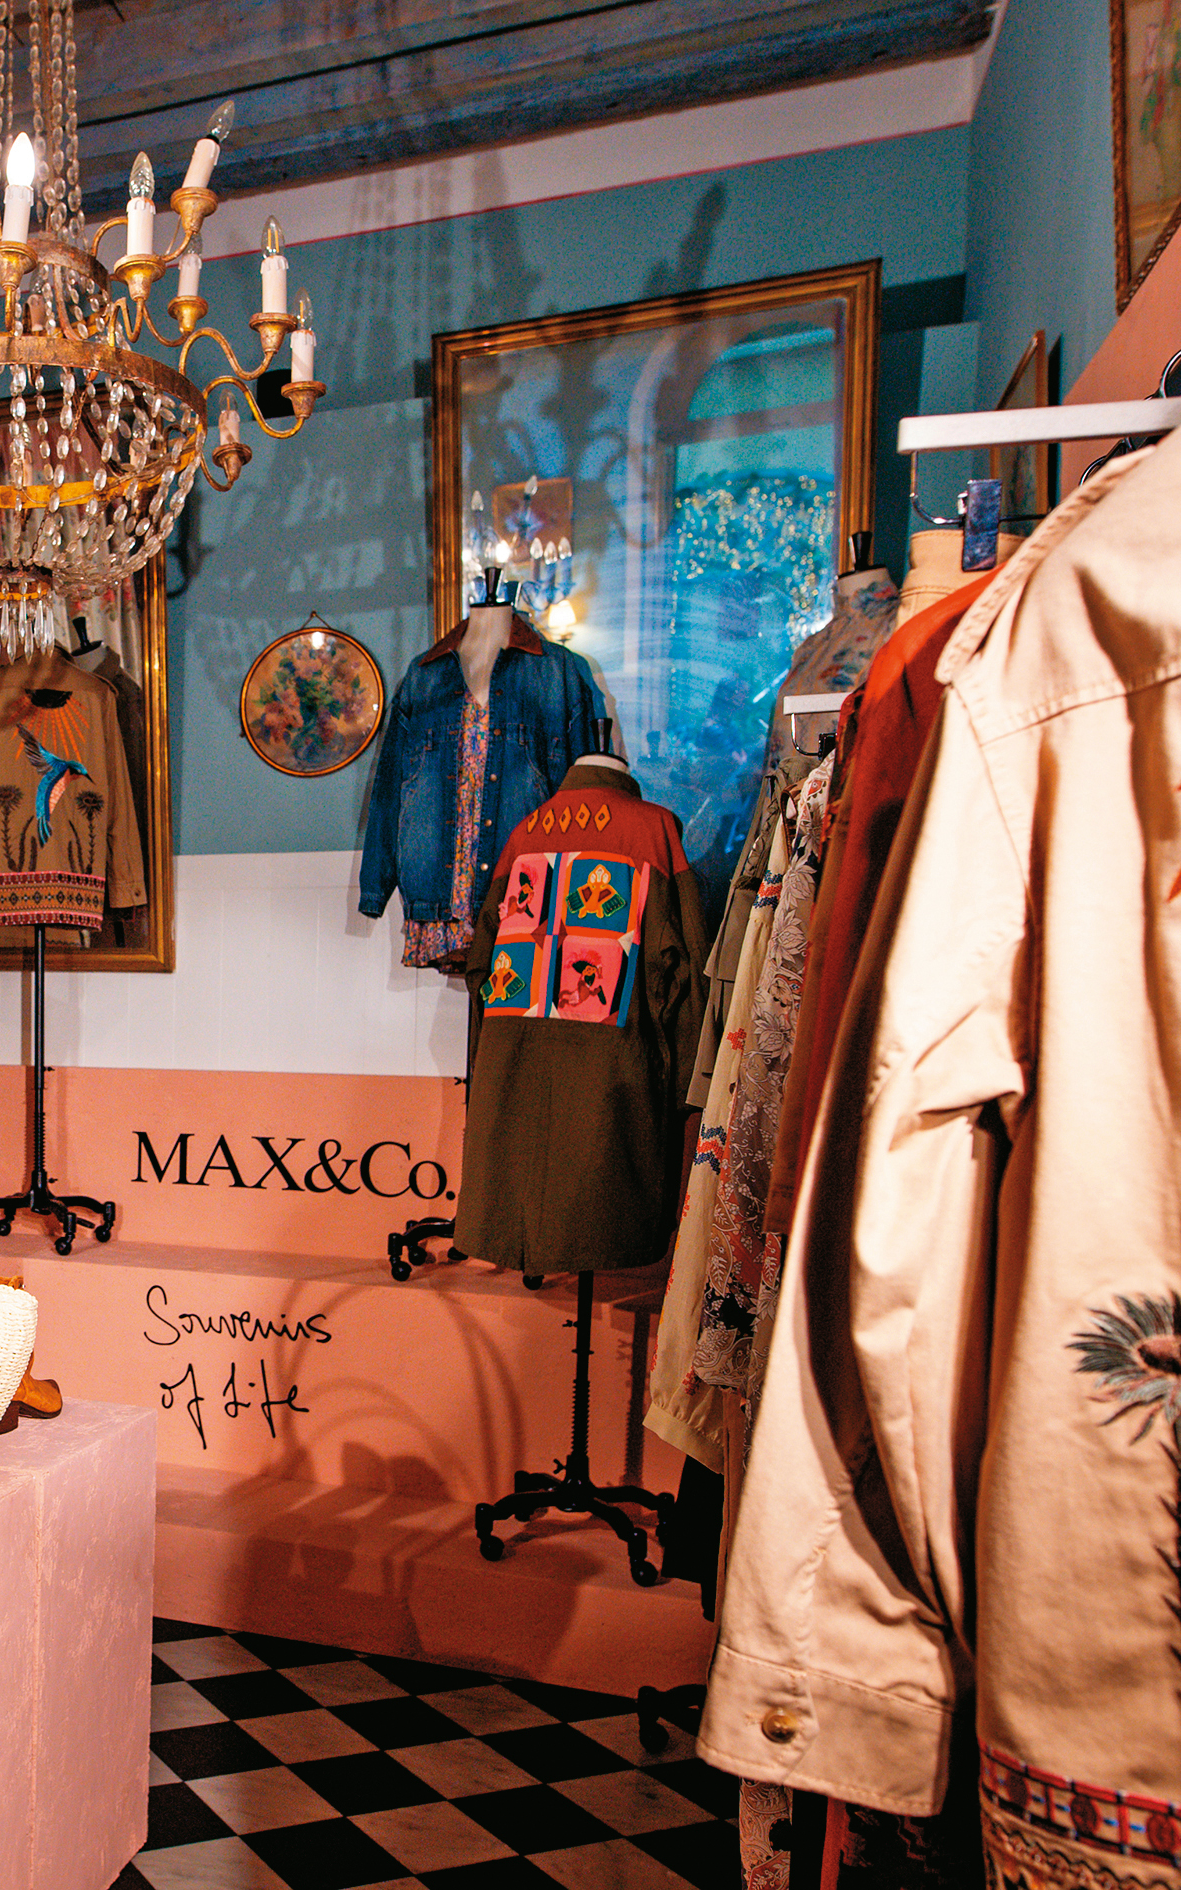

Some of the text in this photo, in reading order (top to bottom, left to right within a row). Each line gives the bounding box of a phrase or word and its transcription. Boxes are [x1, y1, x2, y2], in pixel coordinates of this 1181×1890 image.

[131, 1131, 456, 1200] MAX&Co.
[144, 1285, 332, 1346] Souvenirs
[160, 1359, 310, 1450] of Life
